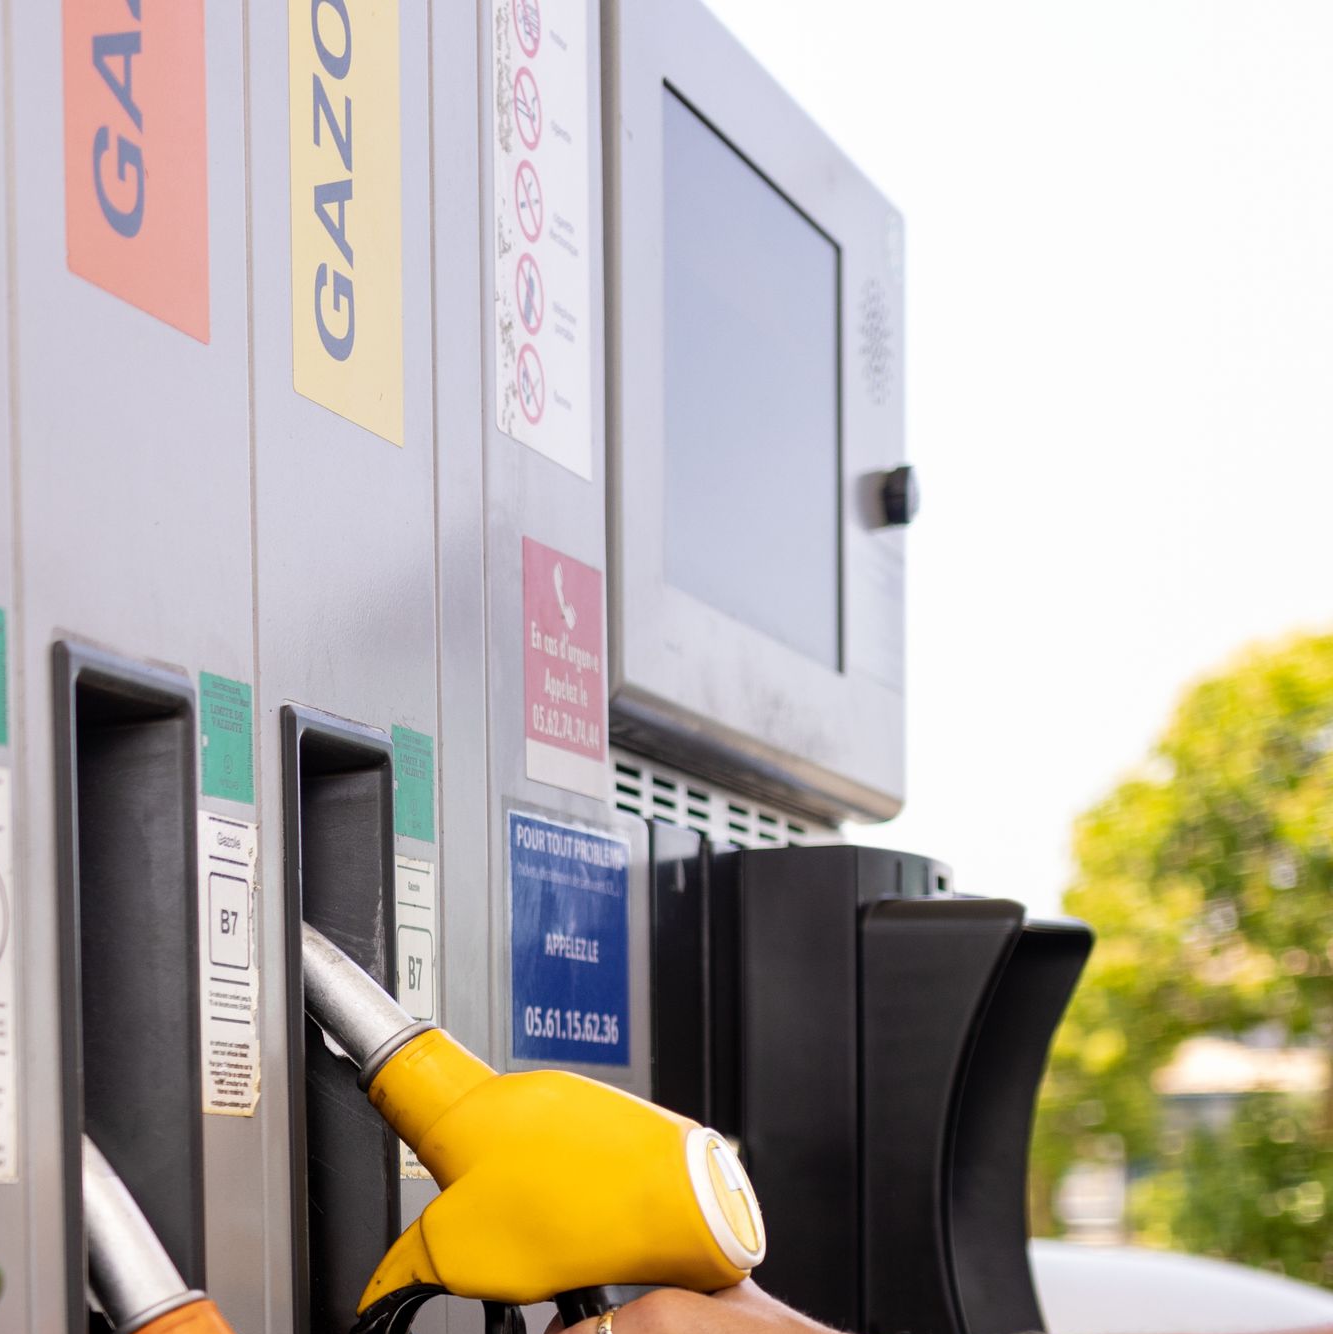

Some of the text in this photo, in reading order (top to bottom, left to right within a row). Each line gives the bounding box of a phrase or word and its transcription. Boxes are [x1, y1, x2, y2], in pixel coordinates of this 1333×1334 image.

[92, 0, 145, 238] GA
[531, 621, 542, 650] En
[544, 634, 558, 657] cas
[544, 667, 588, 708] Appelez le
[516, 824, 546, 852] POUR
[547, 831, 572, 859] TOUT
[220, 908, 238, 936] B7
[545, 932, 600, 963] APPELEZ LE
[408, 955, 423, 991] B7
[525, 1005, 619, 1045] 05.61.15.62.36
